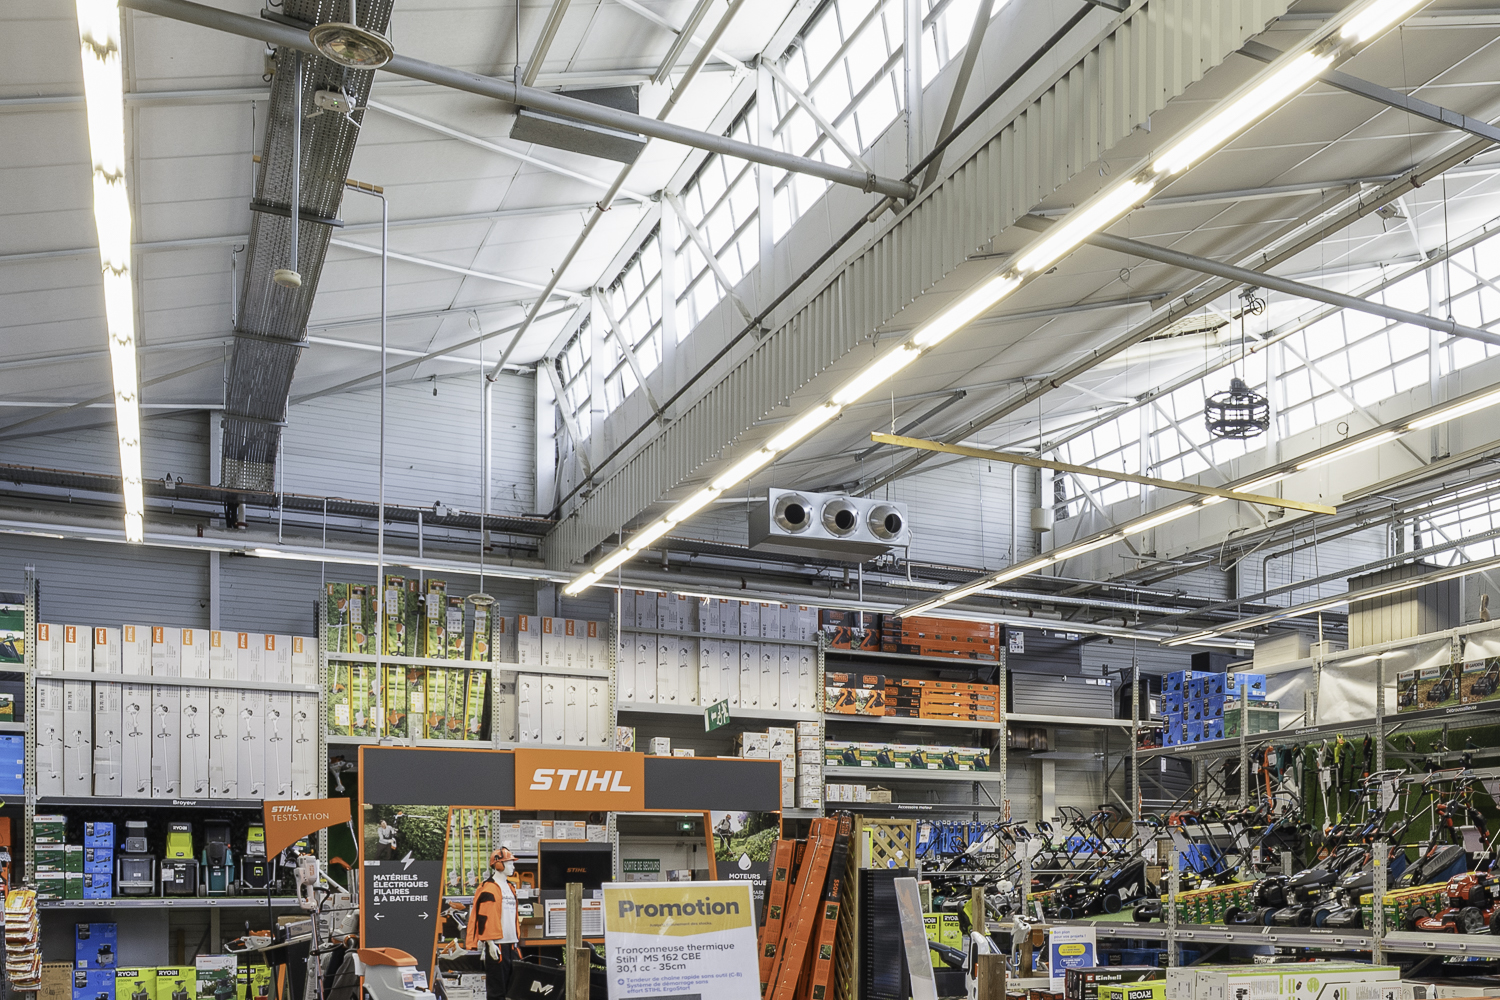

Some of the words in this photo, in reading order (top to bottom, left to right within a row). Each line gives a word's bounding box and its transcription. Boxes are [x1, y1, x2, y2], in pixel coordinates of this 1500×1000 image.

[530, 768, 631, 792] STIHL
[272, 812, 329, 822] TESTSTATION
[624, 861, 637, 870] SORTIE
[638, 861, 642, 870] DE
[643, 861, 659, 870] SECOURS
[373, 880, 429, 888] ÉLECTRIQUES
[390, 894, 428, 902] BATTERIE
[618, 897, 739, 918] Promotion
[616, 946, 684, 955] Tronçonneuse
[687, 943, 734, 951] thermique
[616, 956, 638, 964] Stihl
[681, 952, 701, 960] CBE
[617, 965, 637, 973] 30,1
[1129, 990, 1152, 1000] RYOBI
